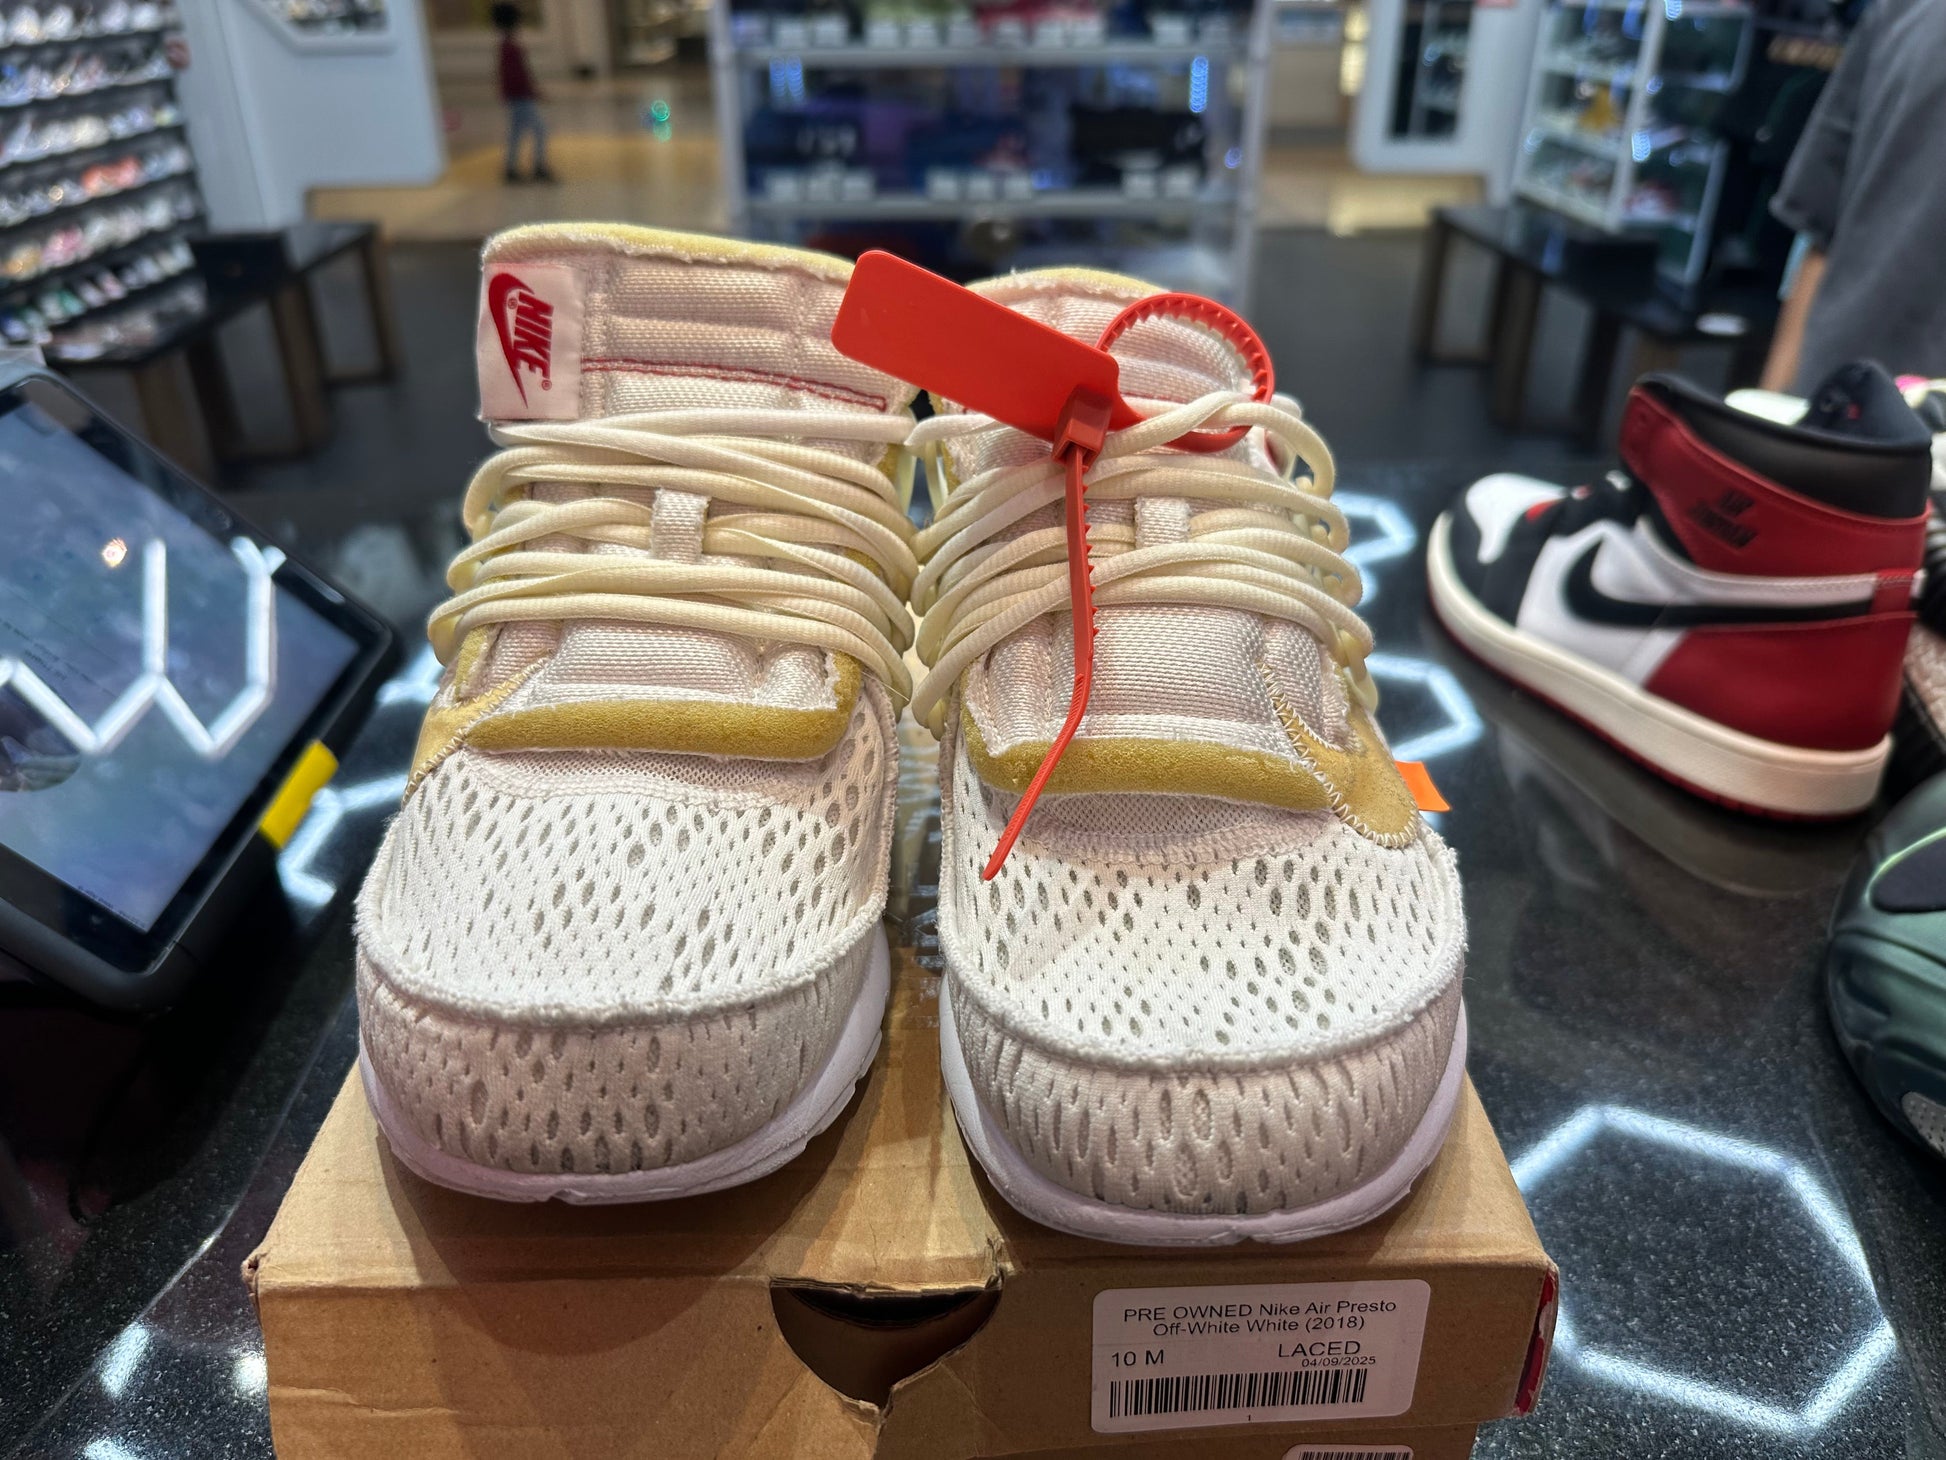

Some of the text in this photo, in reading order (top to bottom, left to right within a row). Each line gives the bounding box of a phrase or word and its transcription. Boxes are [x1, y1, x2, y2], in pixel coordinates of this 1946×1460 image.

[513, 290, 555, 380] NIKE
[1123, 1300, 1397, 1322] PRE OWNED Nike Air Presto
[1153, 1315, 1365, 1336] Off-White White (2018)
[1112, 1349, 1165, 1367] 10 M
[1278, 1340, 1361, 1358] LACED
[1301, 1356, 1376, 1368] 04/09/2025
